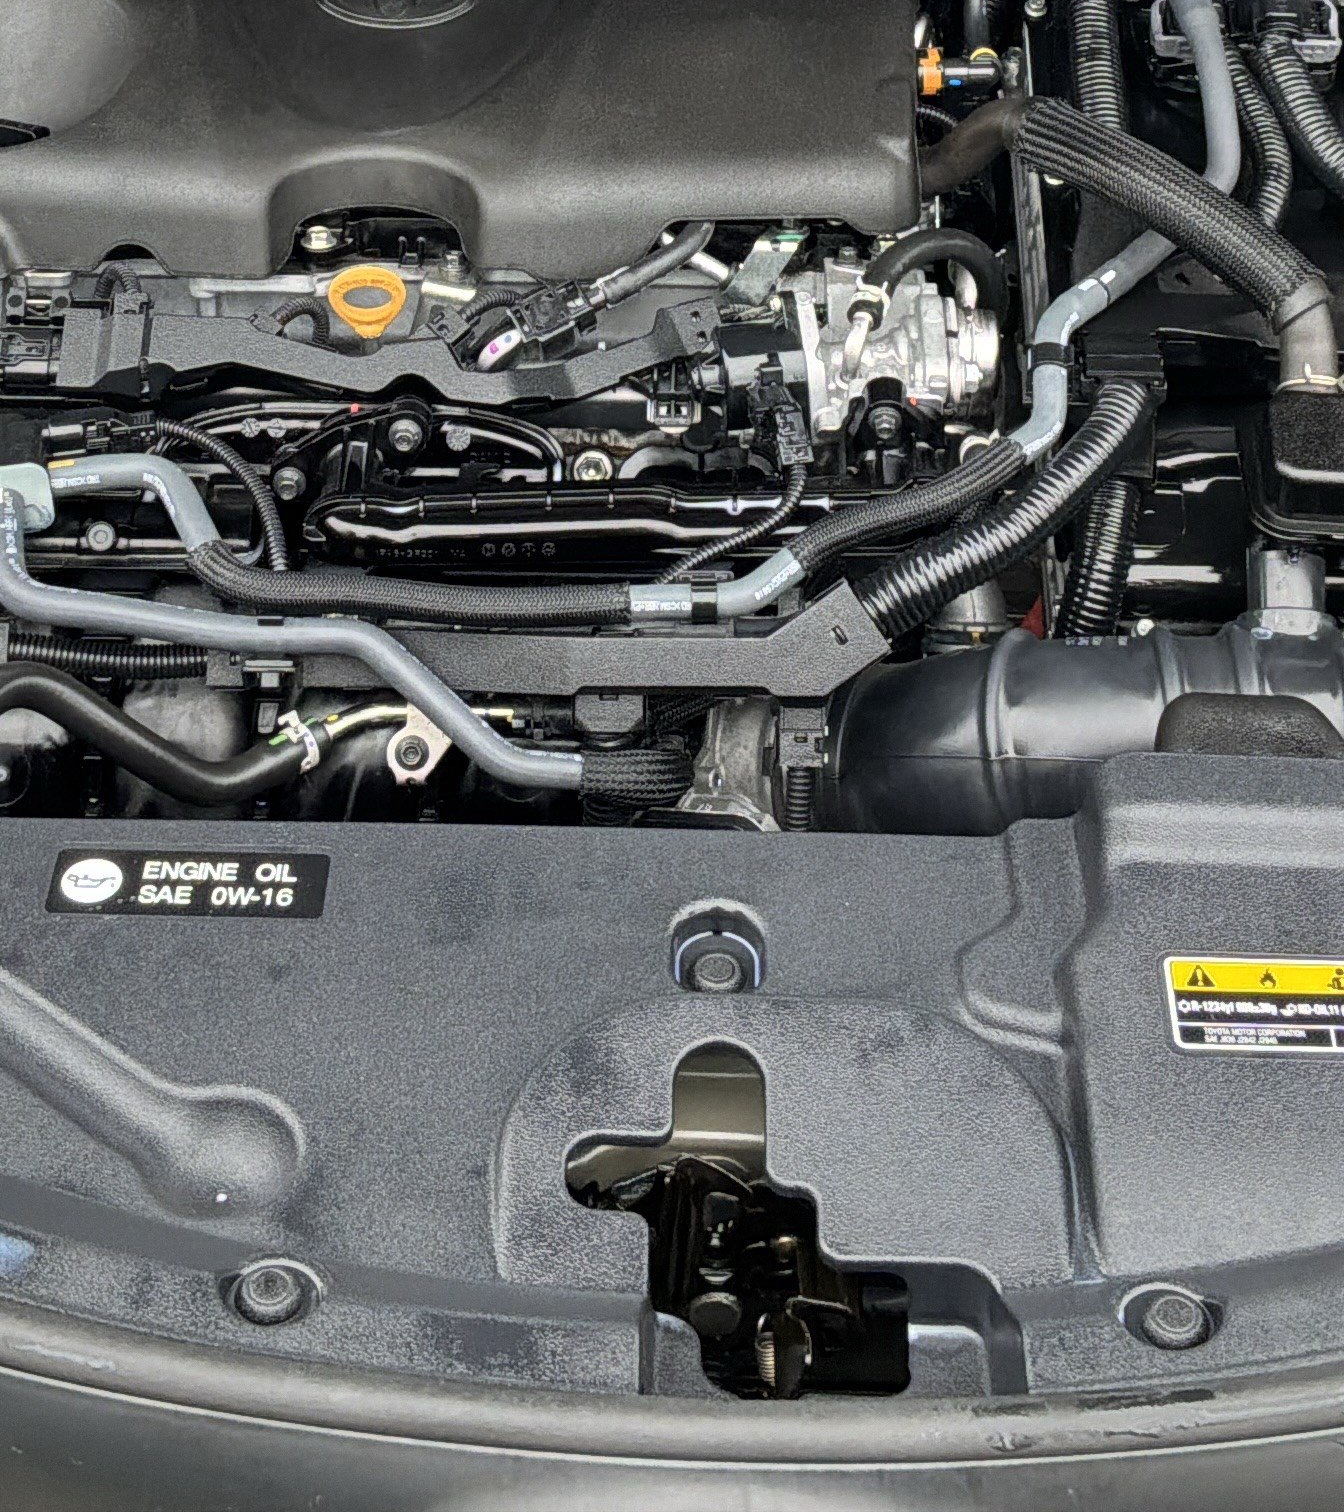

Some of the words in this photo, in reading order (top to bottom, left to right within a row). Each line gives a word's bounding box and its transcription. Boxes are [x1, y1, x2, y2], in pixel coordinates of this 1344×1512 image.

[141, 861, 240, 882] ENGINE
[254, 863, 298, 884] OIL
[137, 885, 193, 905] SAE
[210, 887, 294, 908] 0W-16
